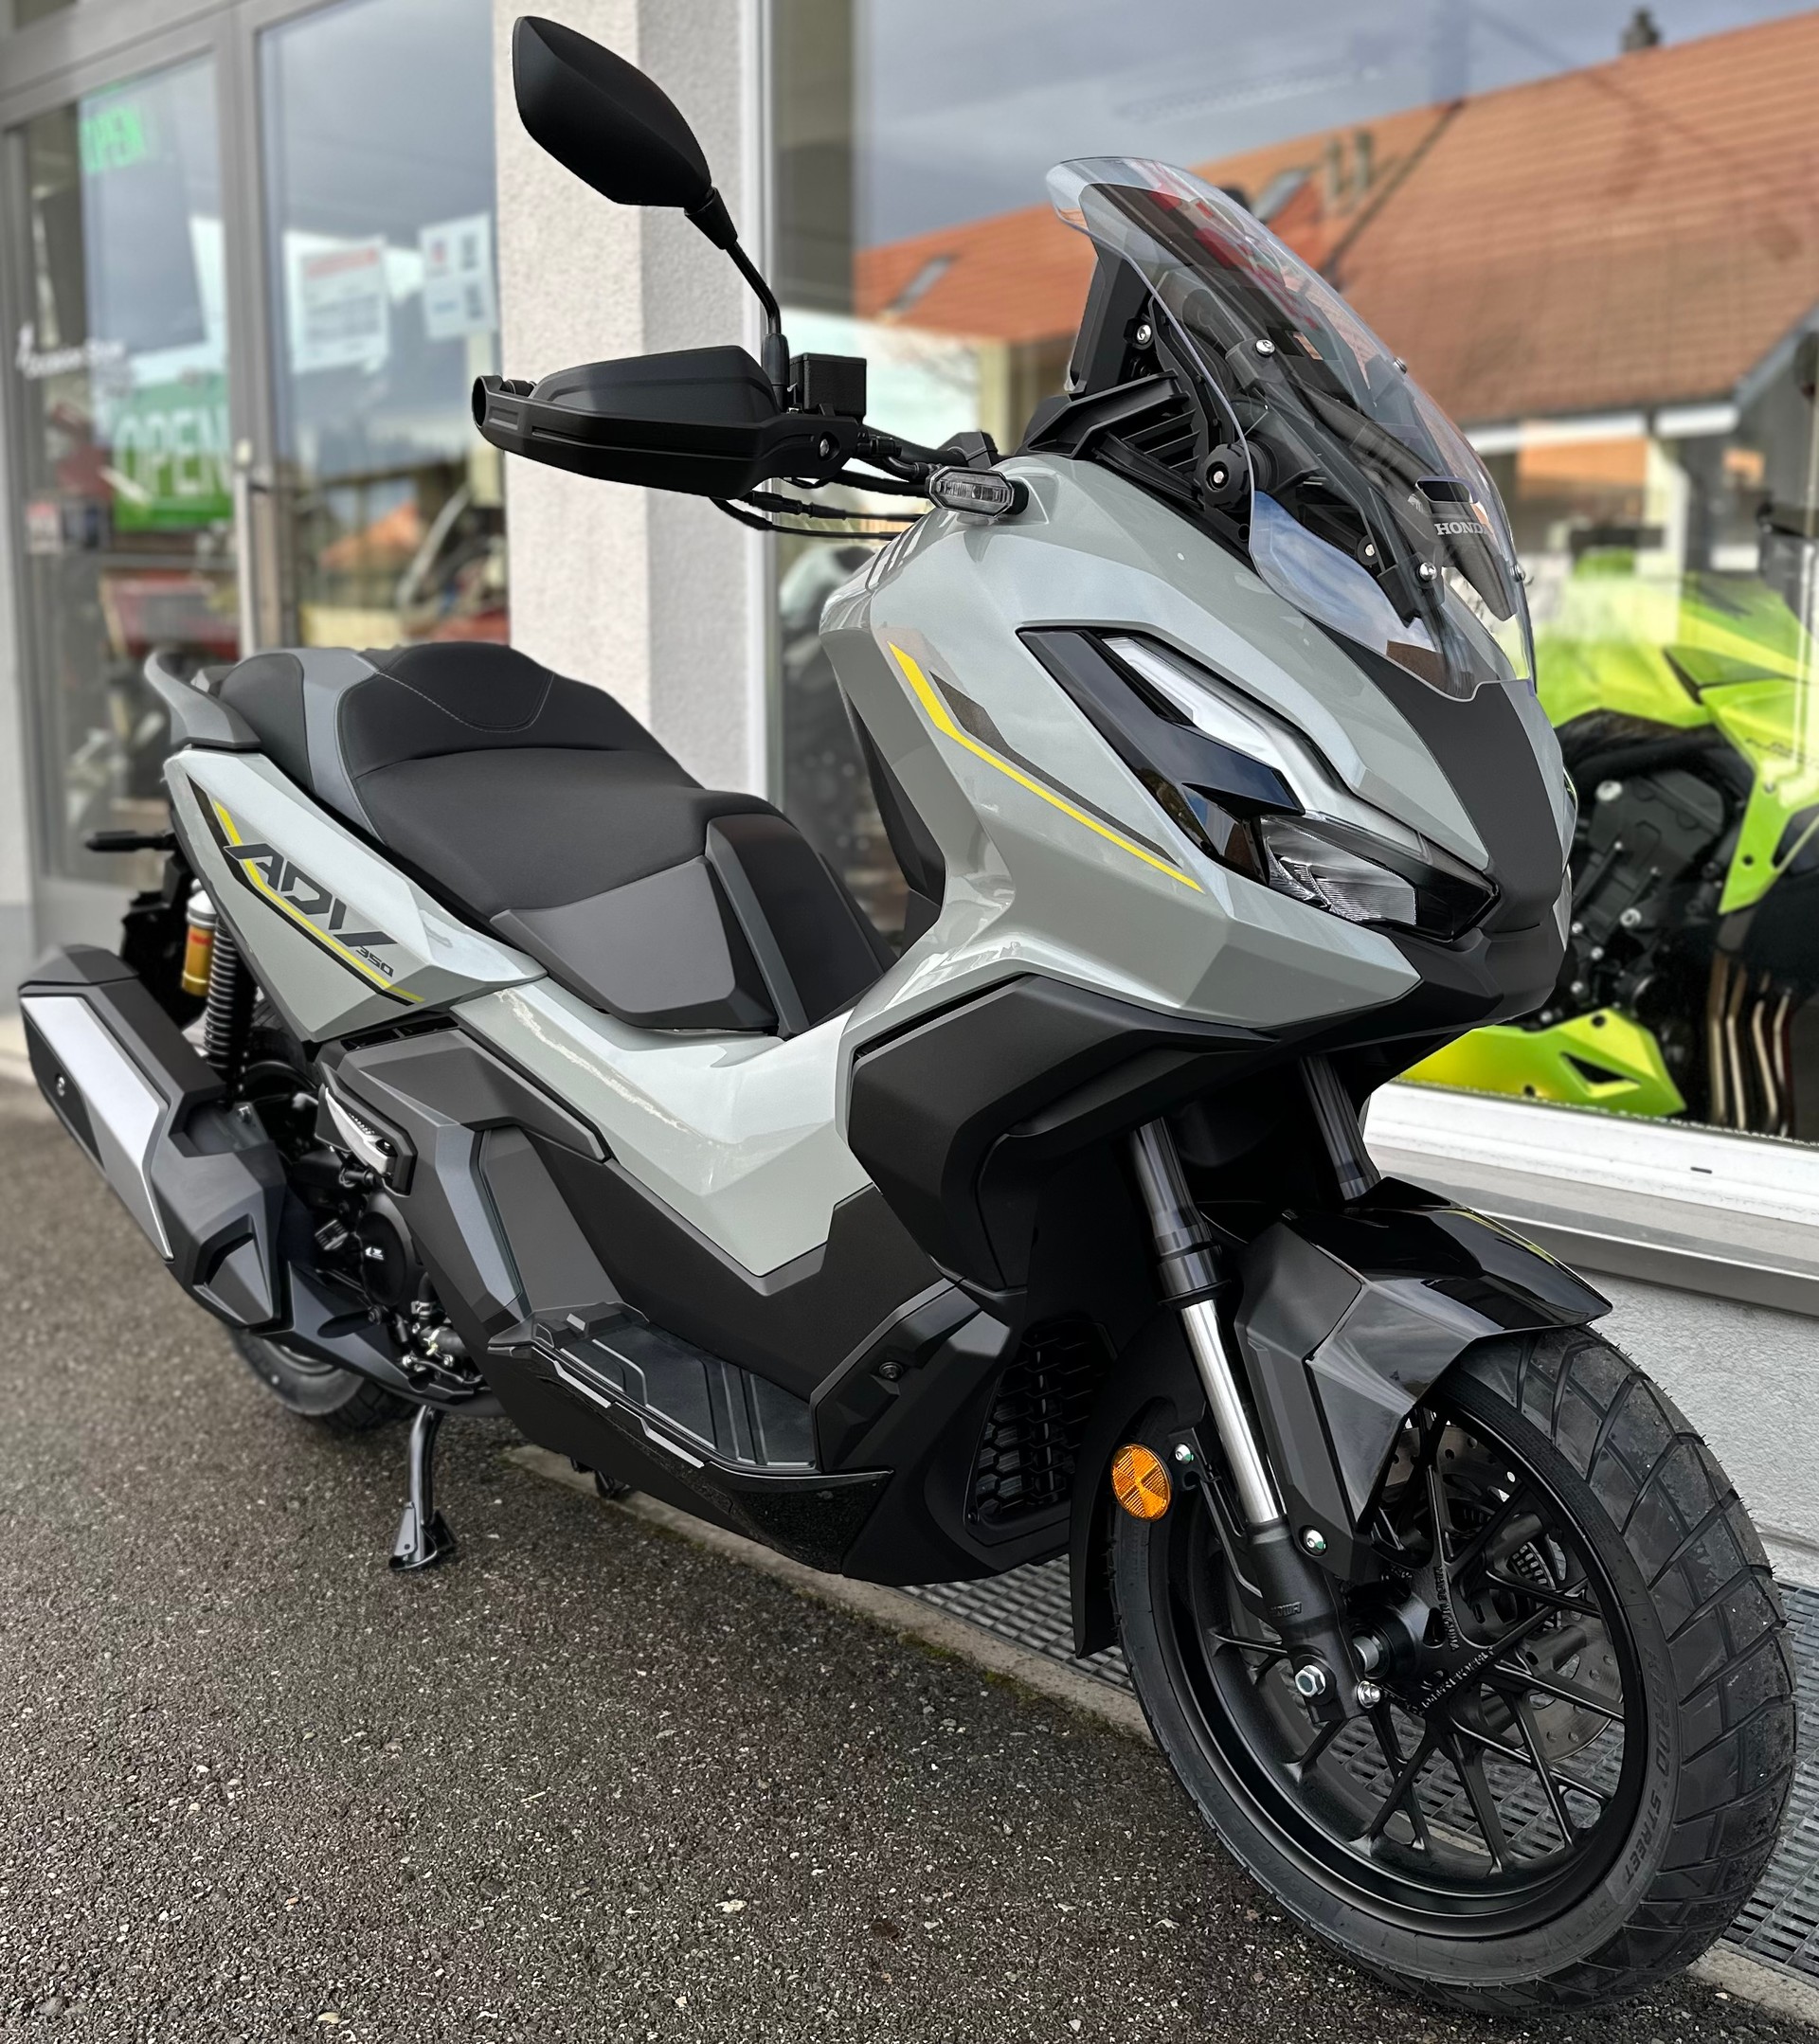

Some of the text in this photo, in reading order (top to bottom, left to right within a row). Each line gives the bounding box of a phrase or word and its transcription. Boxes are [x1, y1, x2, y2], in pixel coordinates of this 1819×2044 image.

[224, 843, 398, 977] ADV 350
[1625, 1788, 1662, 1885] STREET
